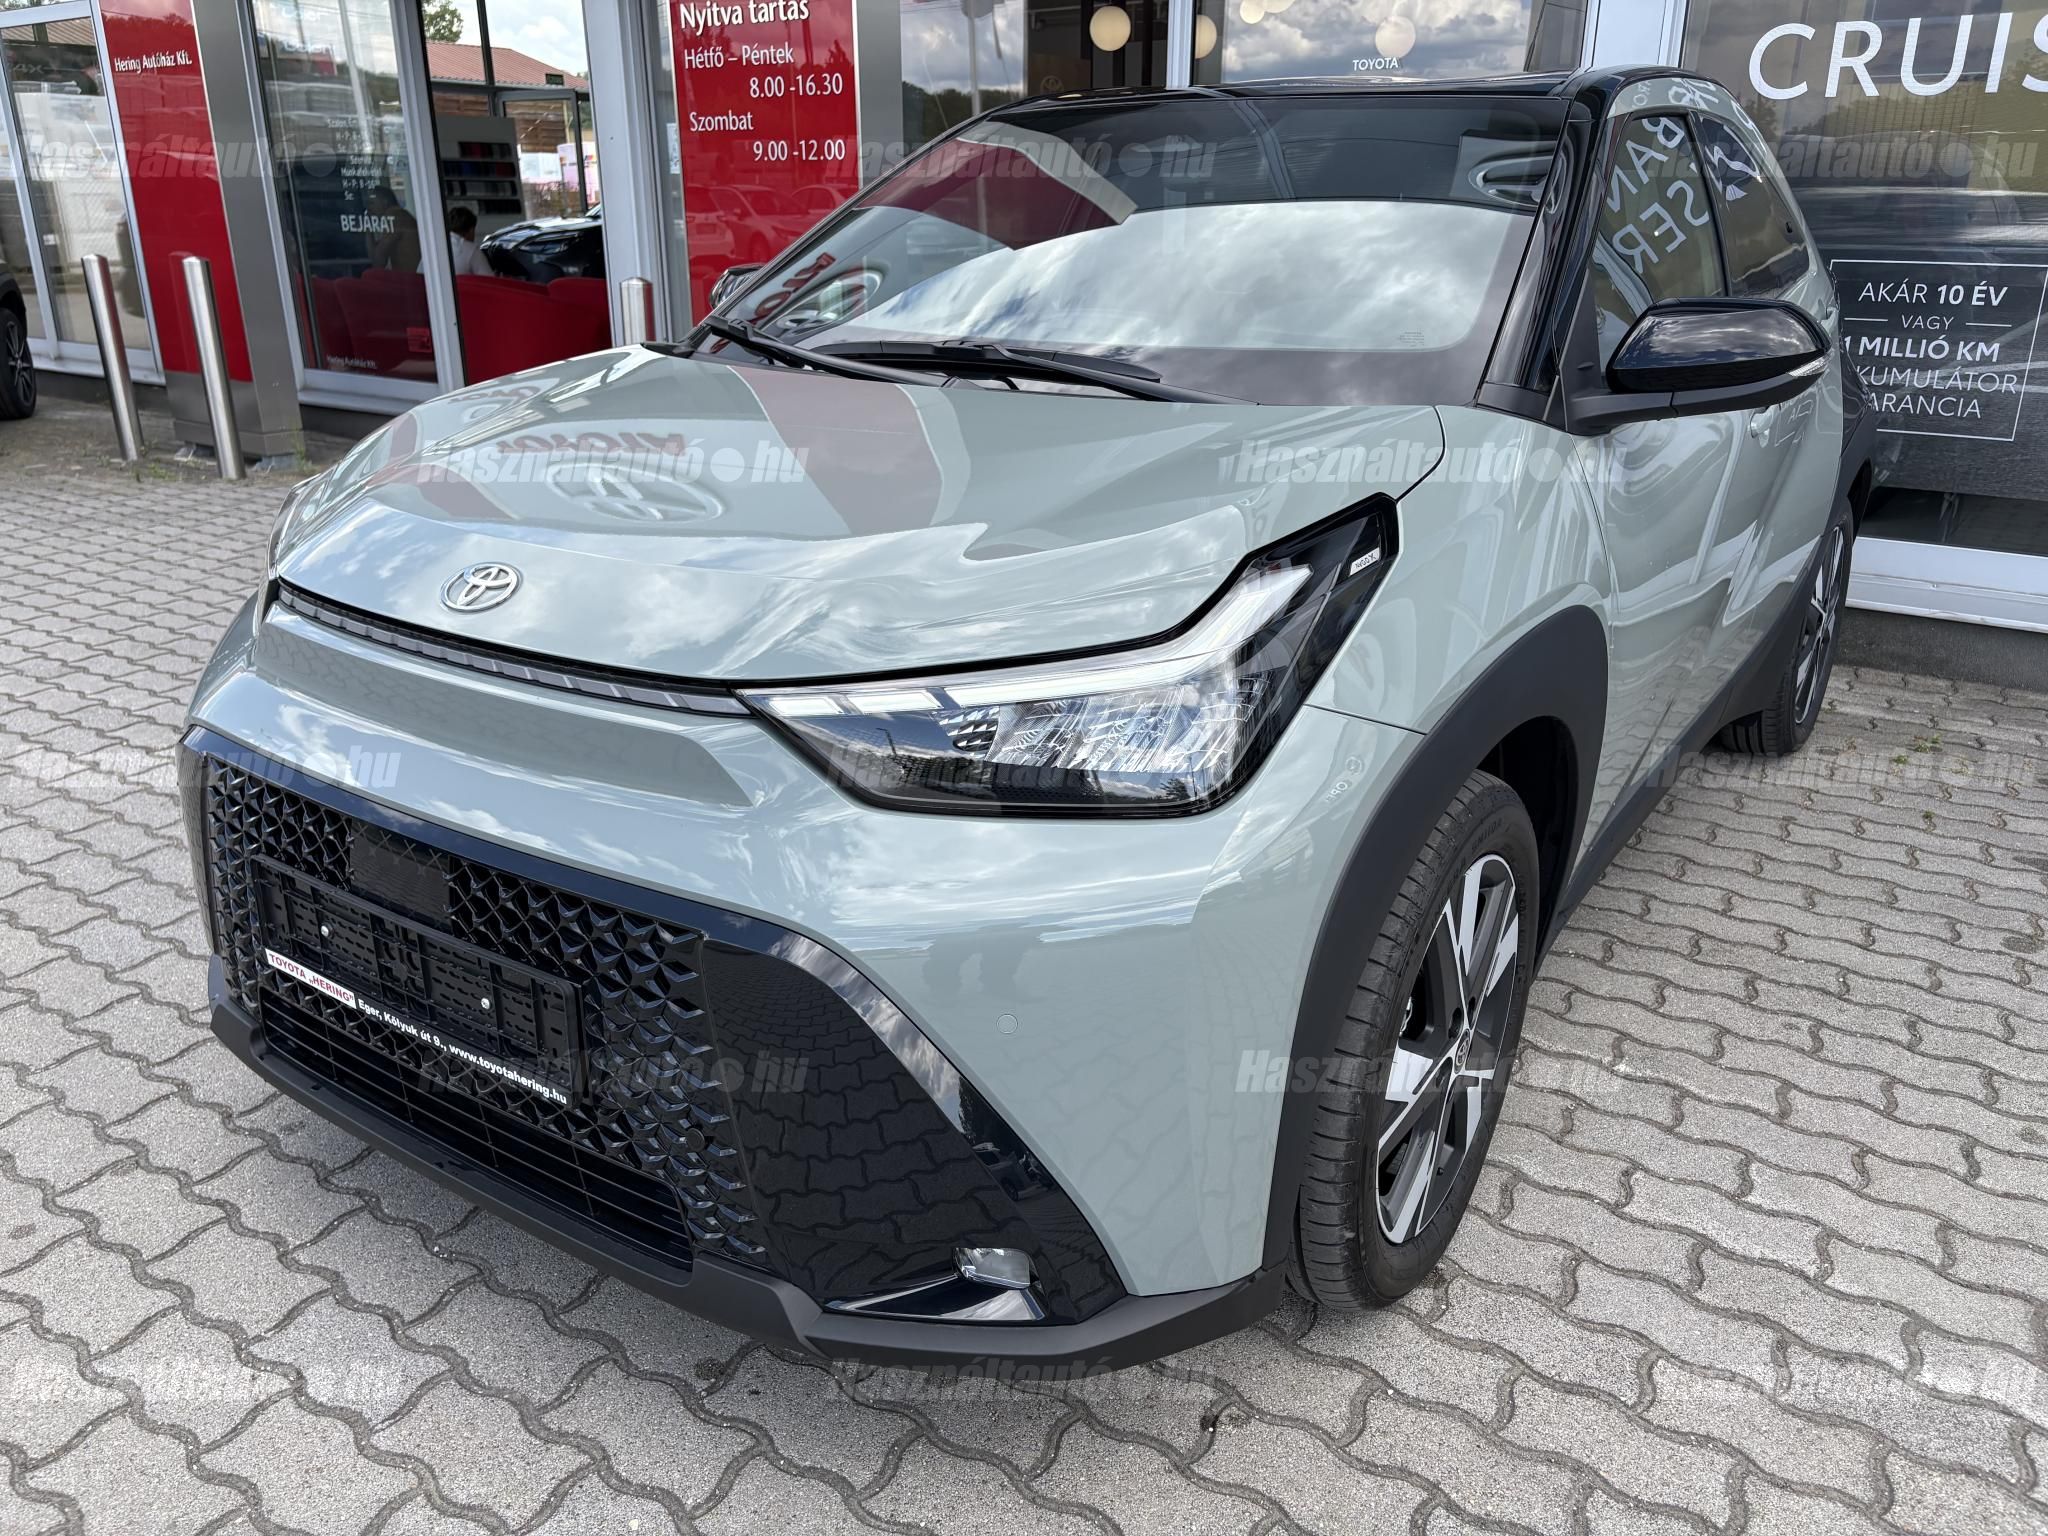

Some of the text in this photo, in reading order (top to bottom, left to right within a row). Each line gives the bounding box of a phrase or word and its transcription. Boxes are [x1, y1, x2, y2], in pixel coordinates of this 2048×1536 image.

[679, 3, 743, 36] Nyitva
[114, 56, 142, 74] Hering
[176, 50, 193, 66] Kft.
[684, 47, 724, 70] Hétfő
[742, 42, 795, 66] Péntek
[1352, 57, 1399, 71] TOYOTA
[750, 76, 785, 98] 8.00
[689, 110, 754, 132] Szombat
[753, 140, 788, 161] 9.00
[340, 210, 395, 233] BEJÁRAT
[1858, 278, 2008, 306] AKÁR 10 ÉV
[1901, 314, 1954, 330] VAGY
[1858, 334, 1950, 360] MILLIÓ
[1956, 340, 2000, 363] KM
[269, 953, 306, 979] TOYOTA
[358, 998, 383, 1021] Eger,
[420, 1029, 432, 1042] út
[449, 1043, 567, 1105] www.toyotahering.hu
